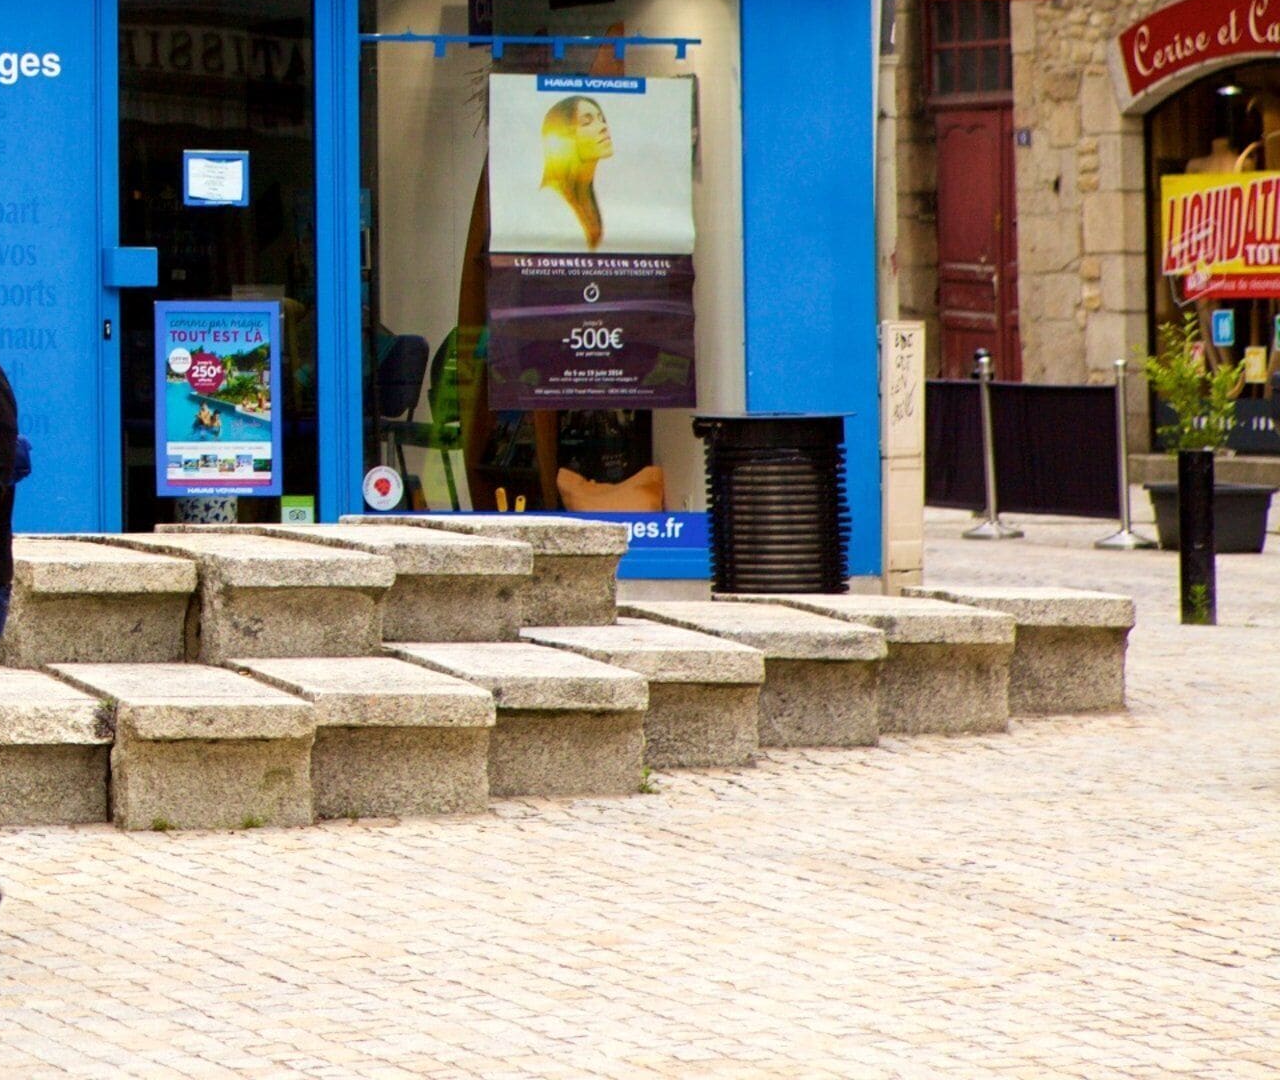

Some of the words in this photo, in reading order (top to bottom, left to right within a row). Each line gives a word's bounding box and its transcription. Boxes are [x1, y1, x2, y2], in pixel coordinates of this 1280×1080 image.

[1133, 24, 1211, 77] Cerise
[1217, 9, 1243, 46] et
[544, 78, 582, 88] HAVAS
[585, 80, 639, 89] VOYAGES
[1164, 177, 1280, 273] LIQUIDATI
[514, 258, 533, 267] LES
[537, 257, 593, 267] JOURNÉES
[597, 259, 629, 267] PLEIN
[633, 259, 671, 268] SOLEIL
[1245, 244, 1280, 265] TOT
[170, 330, 208, 342] TOUT
[213, 330, 240, 342] EST
[245, 328, 263, 342] LÀ
[562, 327, 624, 349] -500€
[192, 365, 221, 378] 250€
